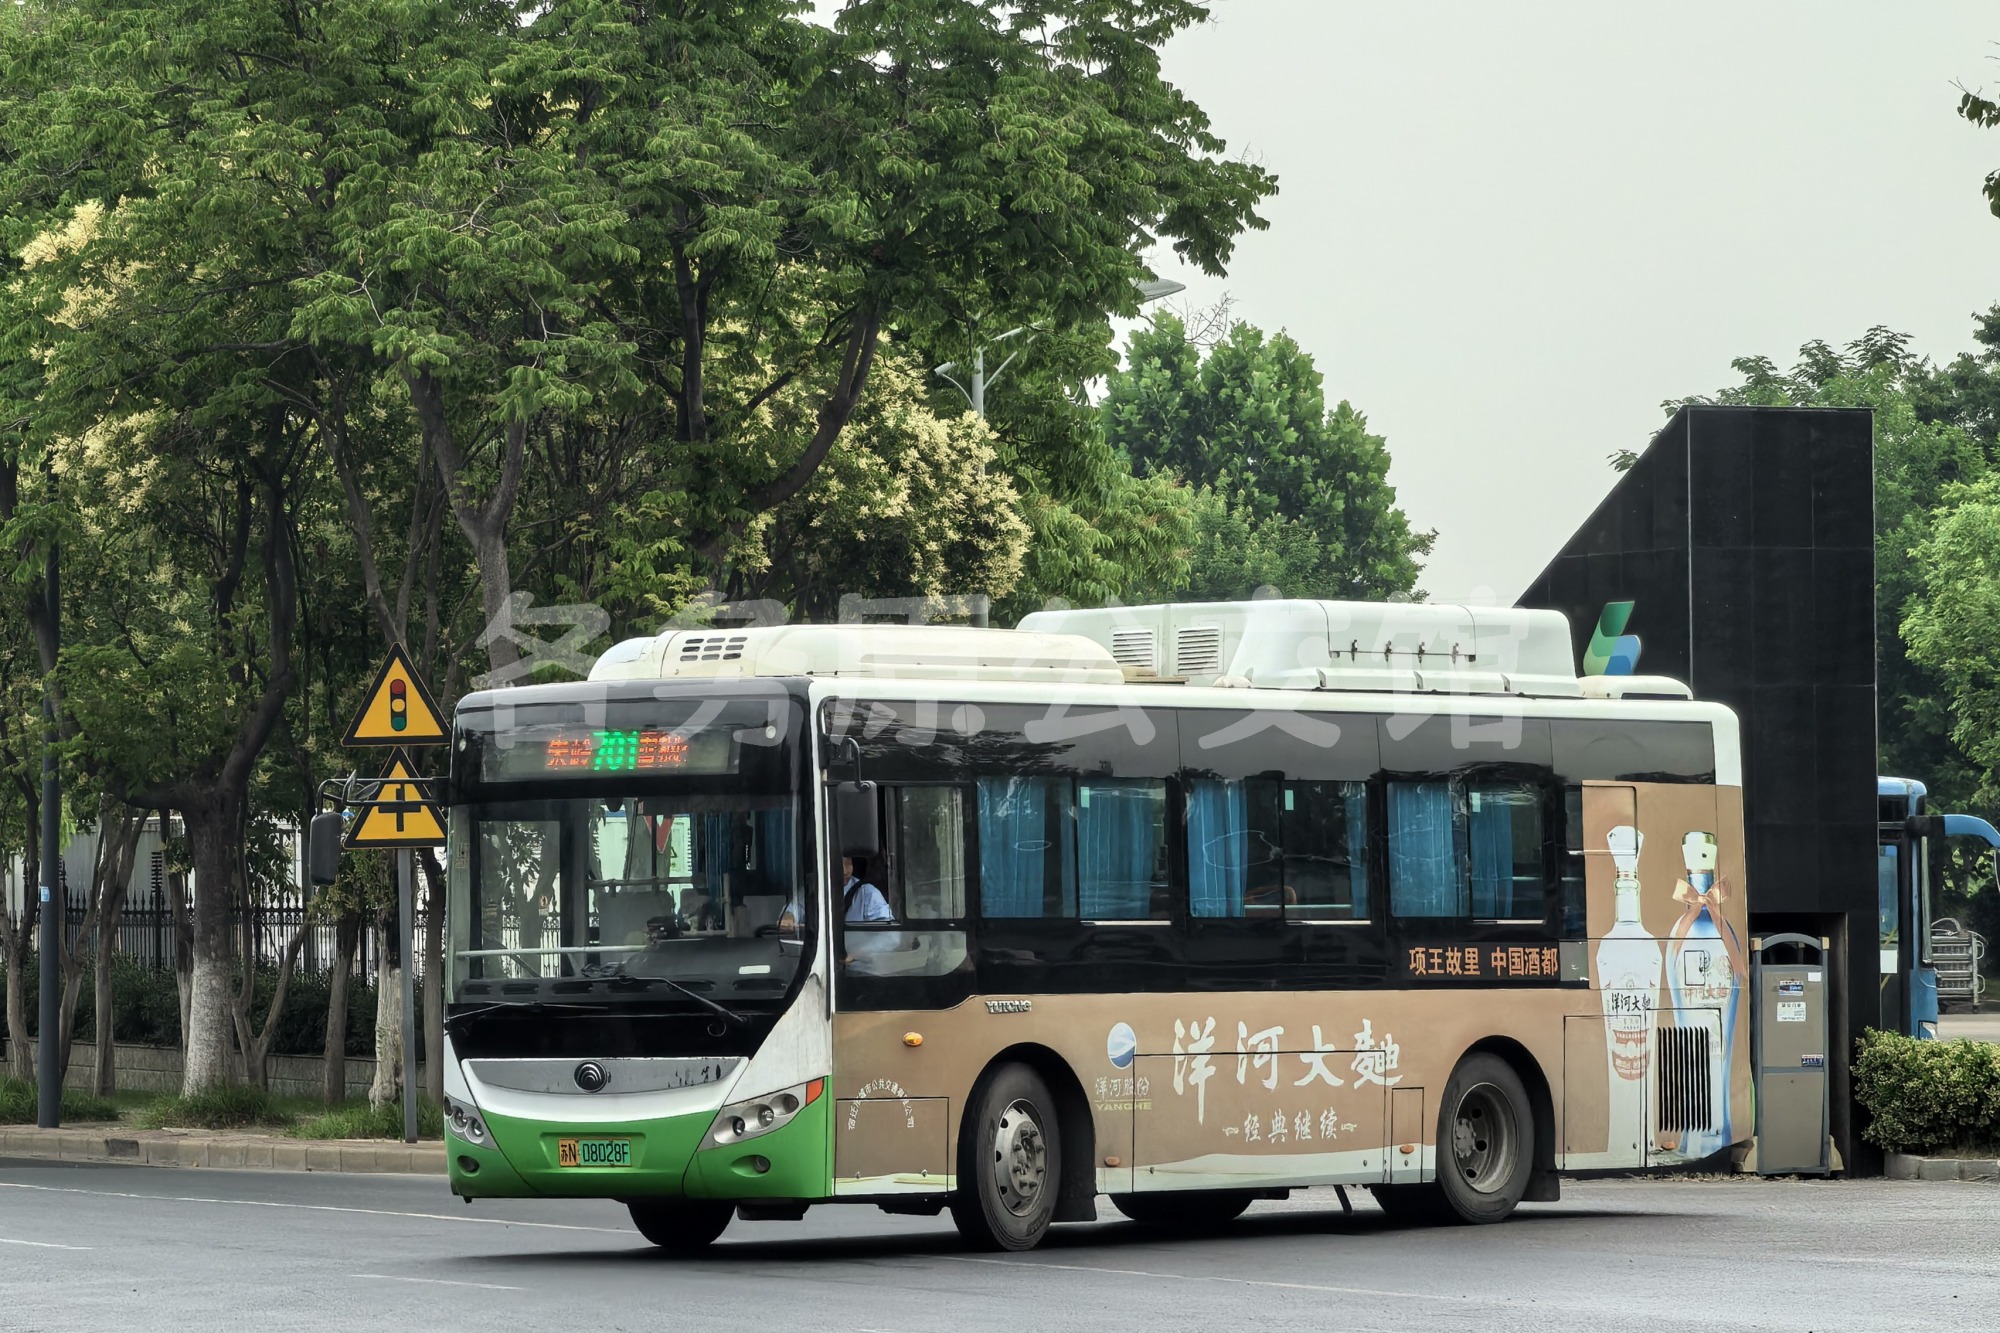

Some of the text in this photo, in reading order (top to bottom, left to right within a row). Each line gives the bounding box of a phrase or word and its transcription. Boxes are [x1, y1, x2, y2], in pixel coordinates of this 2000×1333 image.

[593, 731, 637, 770] 701
[1409, 947, 1559, 976] 项王故里 中国酒都
[985, 999, 1032, 1014] YUTONG
[1095, 1076, 1151, 1100] 洋河股份
[1095, 1102, 1153, 1111] YANGHE
